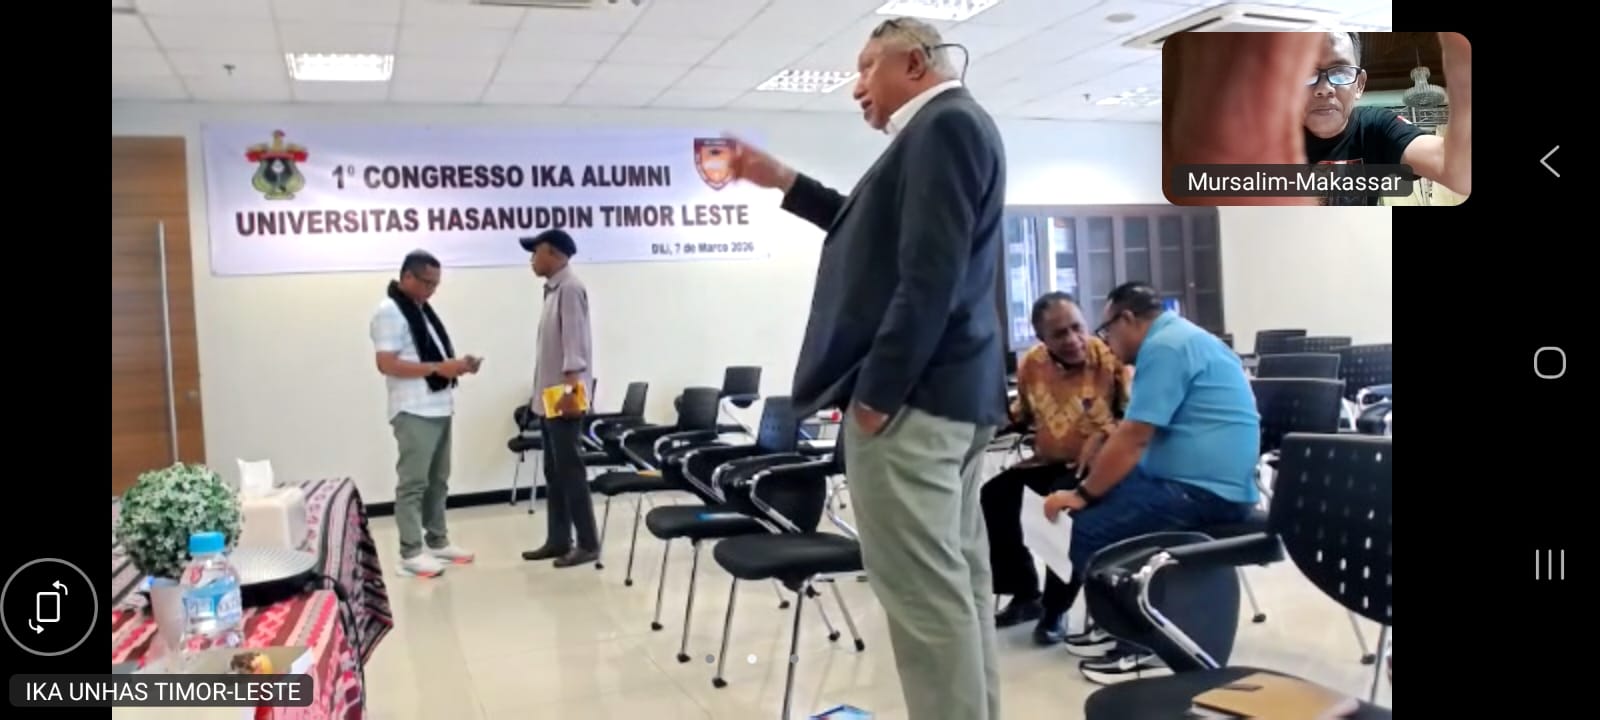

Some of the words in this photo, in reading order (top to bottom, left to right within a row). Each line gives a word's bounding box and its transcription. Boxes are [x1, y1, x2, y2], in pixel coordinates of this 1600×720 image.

[363, 164, 524, 190] CONGRESSO
[531, 164, 575, 189] IKA
[581, 165, 671, 188] ALUMNI
[235, 208, 419, 237] UNIVERSITAS
[427, 206, 593, 231] HASANUDDIN
[600, 204, 675, 228] TIMOR
[681, 203, 750, 226] LESTE
